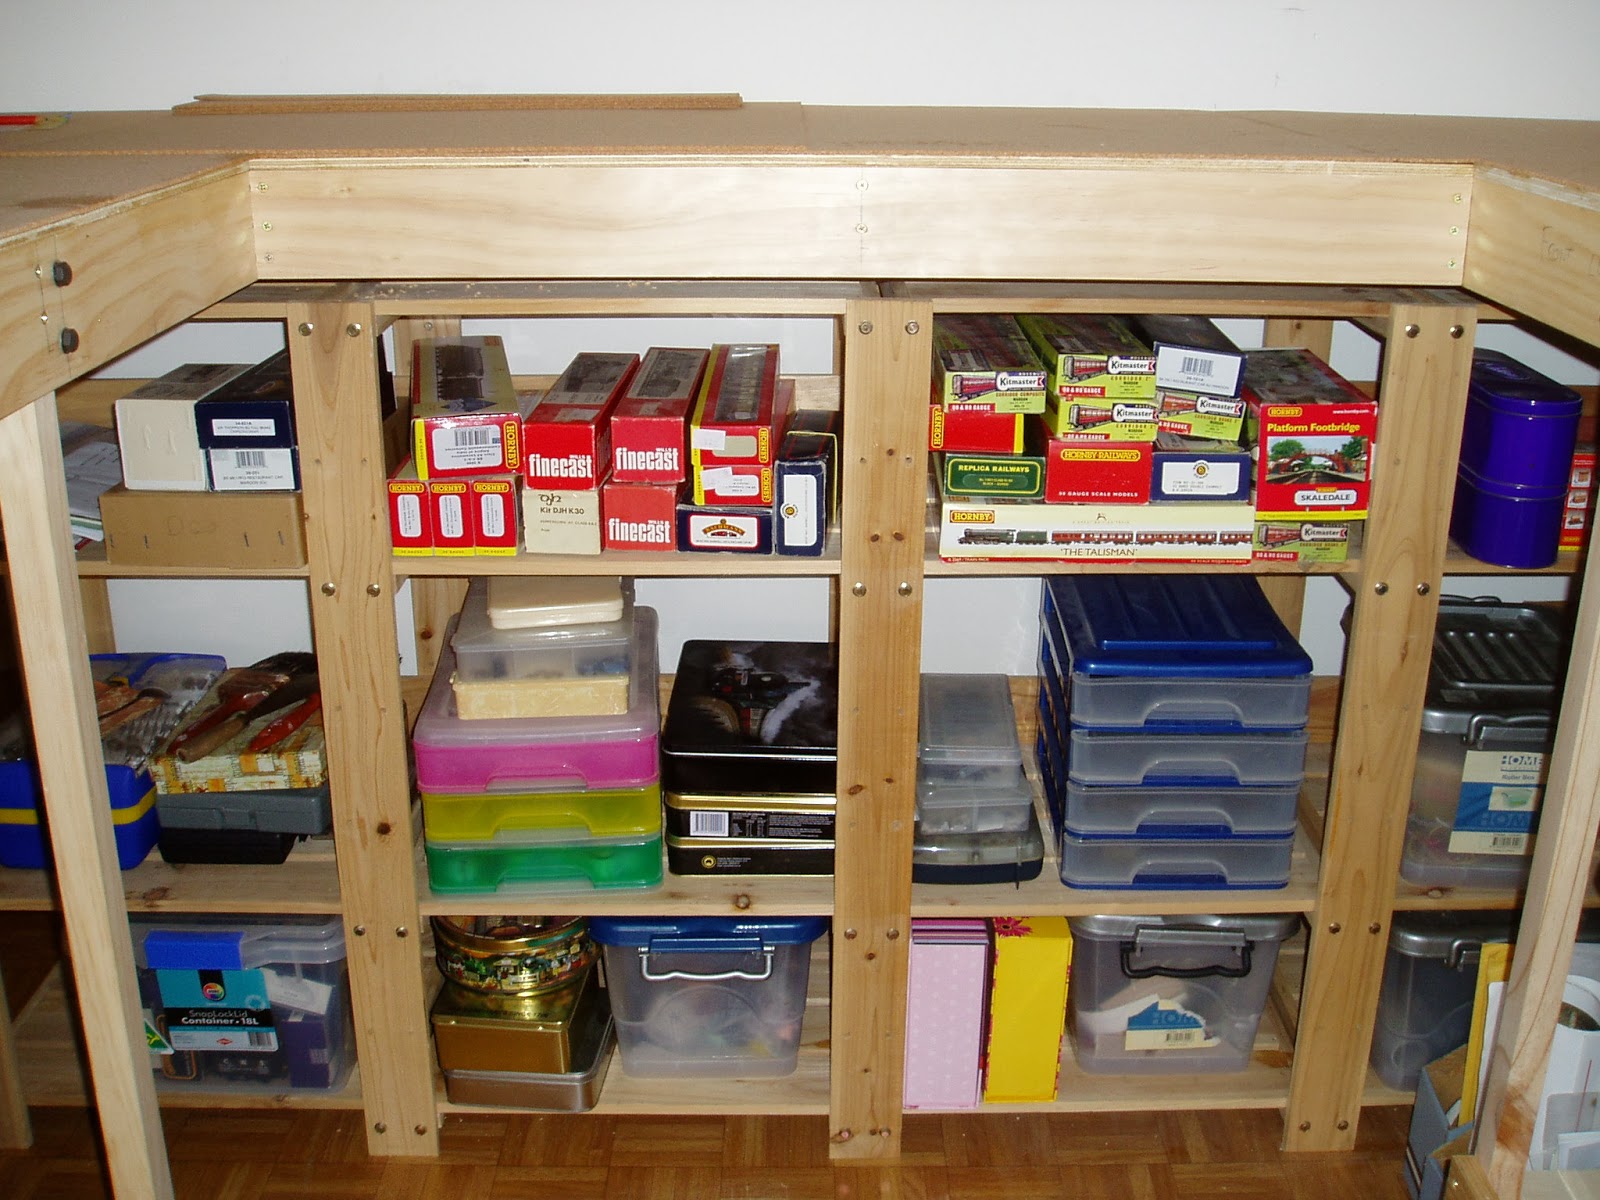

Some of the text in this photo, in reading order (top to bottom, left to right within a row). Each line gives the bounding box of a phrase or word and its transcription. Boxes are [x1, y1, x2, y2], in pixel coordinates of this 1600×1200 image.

[1111, 360, 1148, 370] Kitmaster
[999, 376, 1036, 387] Kitmaster
[1199, 399, 1234, 411] Kitmaster
[1116, 408, 1152, 418] Kitmaster
[1271, 408, 1300, 416] HORNBY
[934, 410, 942, 446] HORNBY
[1267, 423, 1360, 433] Platform Footbridge
[506, 424, 517, 468] HORNBY
[760, 429, 768, 462] HORNBY
[616, 447, 680, 471] finecast
[1065, 451, 1137, 460] HORNBY RAILWAYS
[529, 454, 592, 478] finecast
[958, 464, 990, 472] REPLICA
[1301, 494, 1350, 502] SKALEDALE
[954, 512, 990, 521] HORNBY
[608, 518, 672, 543] finecast
[1304, 528, 1340, 536] Kitmaster
[189, 1010, 248, 1018] SnapLockLid
[182, 1017, 234, 1025] Container
